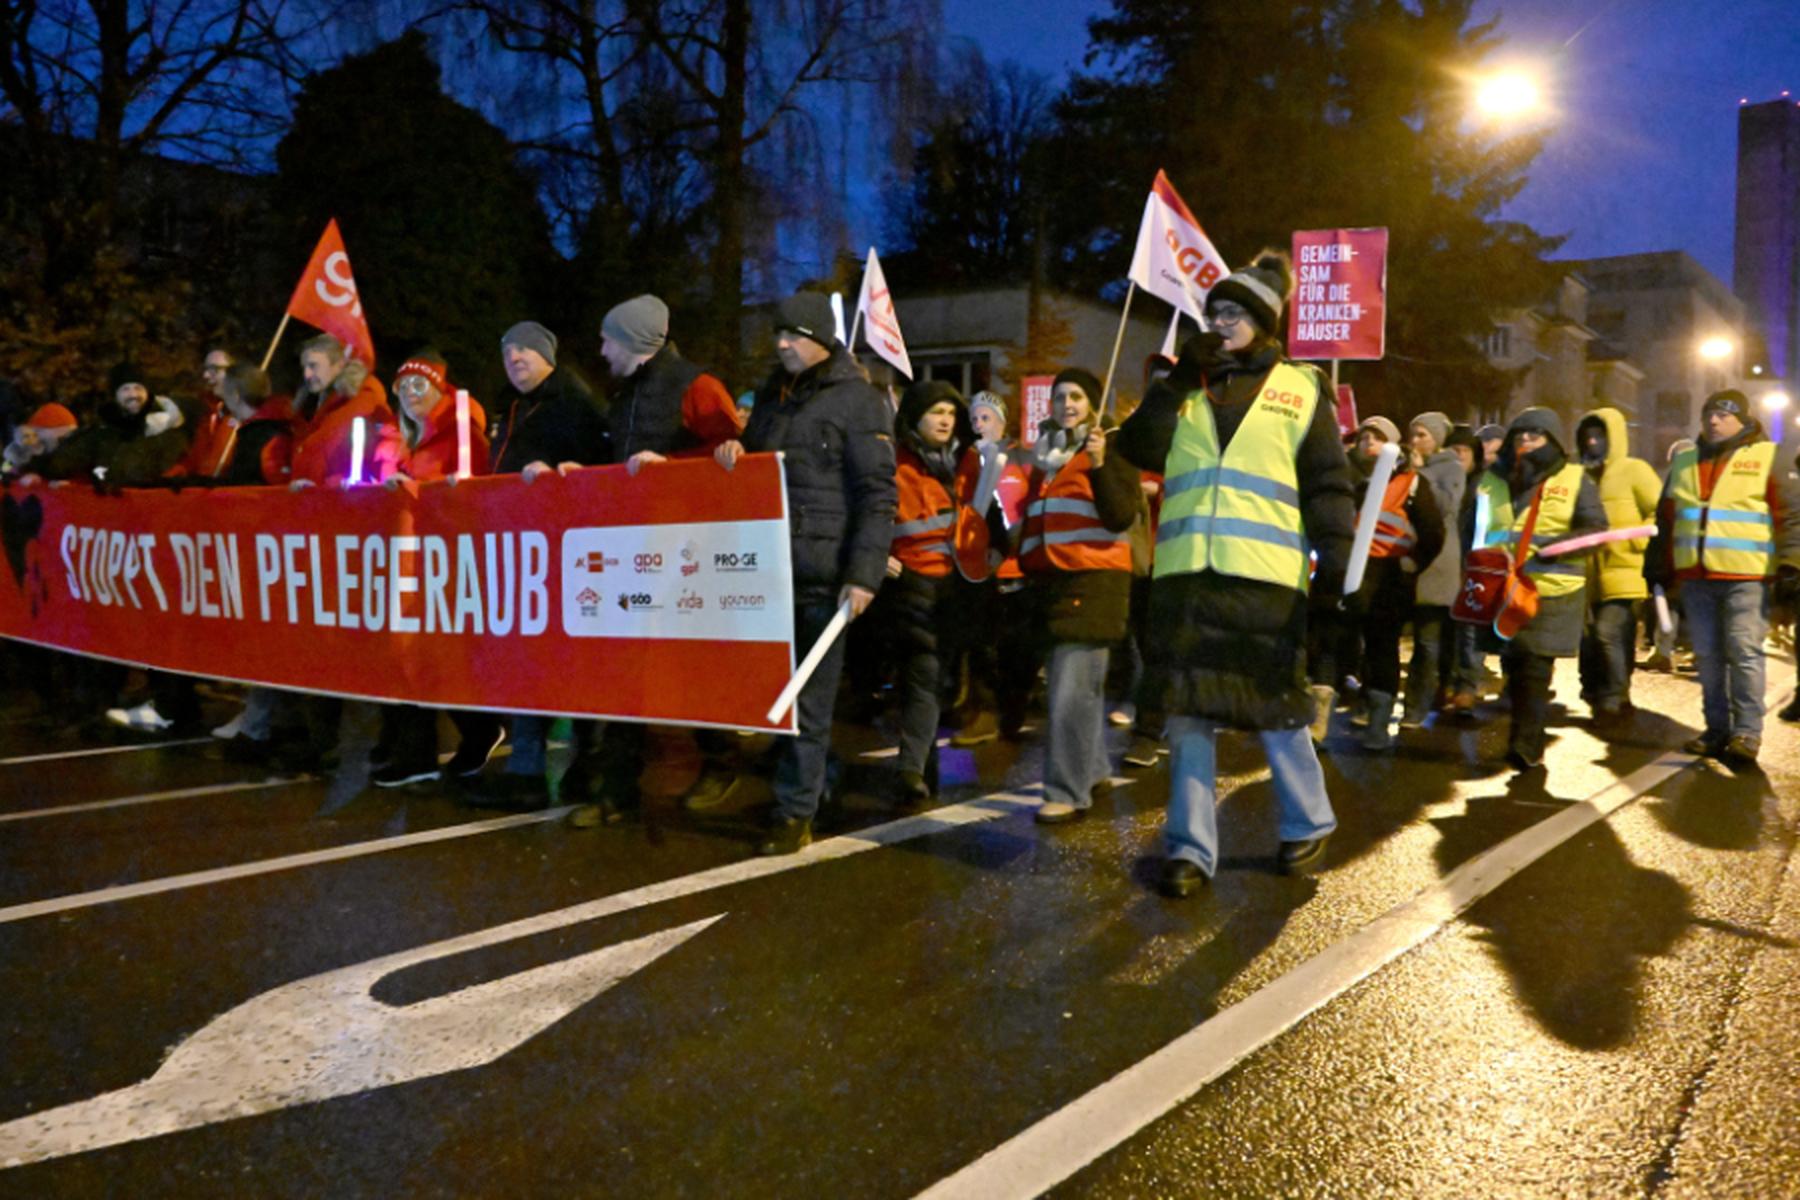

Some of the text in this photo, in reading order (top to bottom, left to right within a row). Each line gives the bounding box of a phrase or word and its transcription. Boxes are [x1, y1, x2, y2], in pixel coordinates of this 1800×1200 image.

[1300, 244, 1358, 262] GEMEIN-
[1300, 265, 1330, 282] SAM
[1299, 282, 1350, 302] FÜR DIE
[1298, 303, 1367, 321] KRANKEN-
[1297, 321, 1350, 340] HÄUSER
[61, 524, 549, 637] STOPPT DEN PFLEGERAUB
